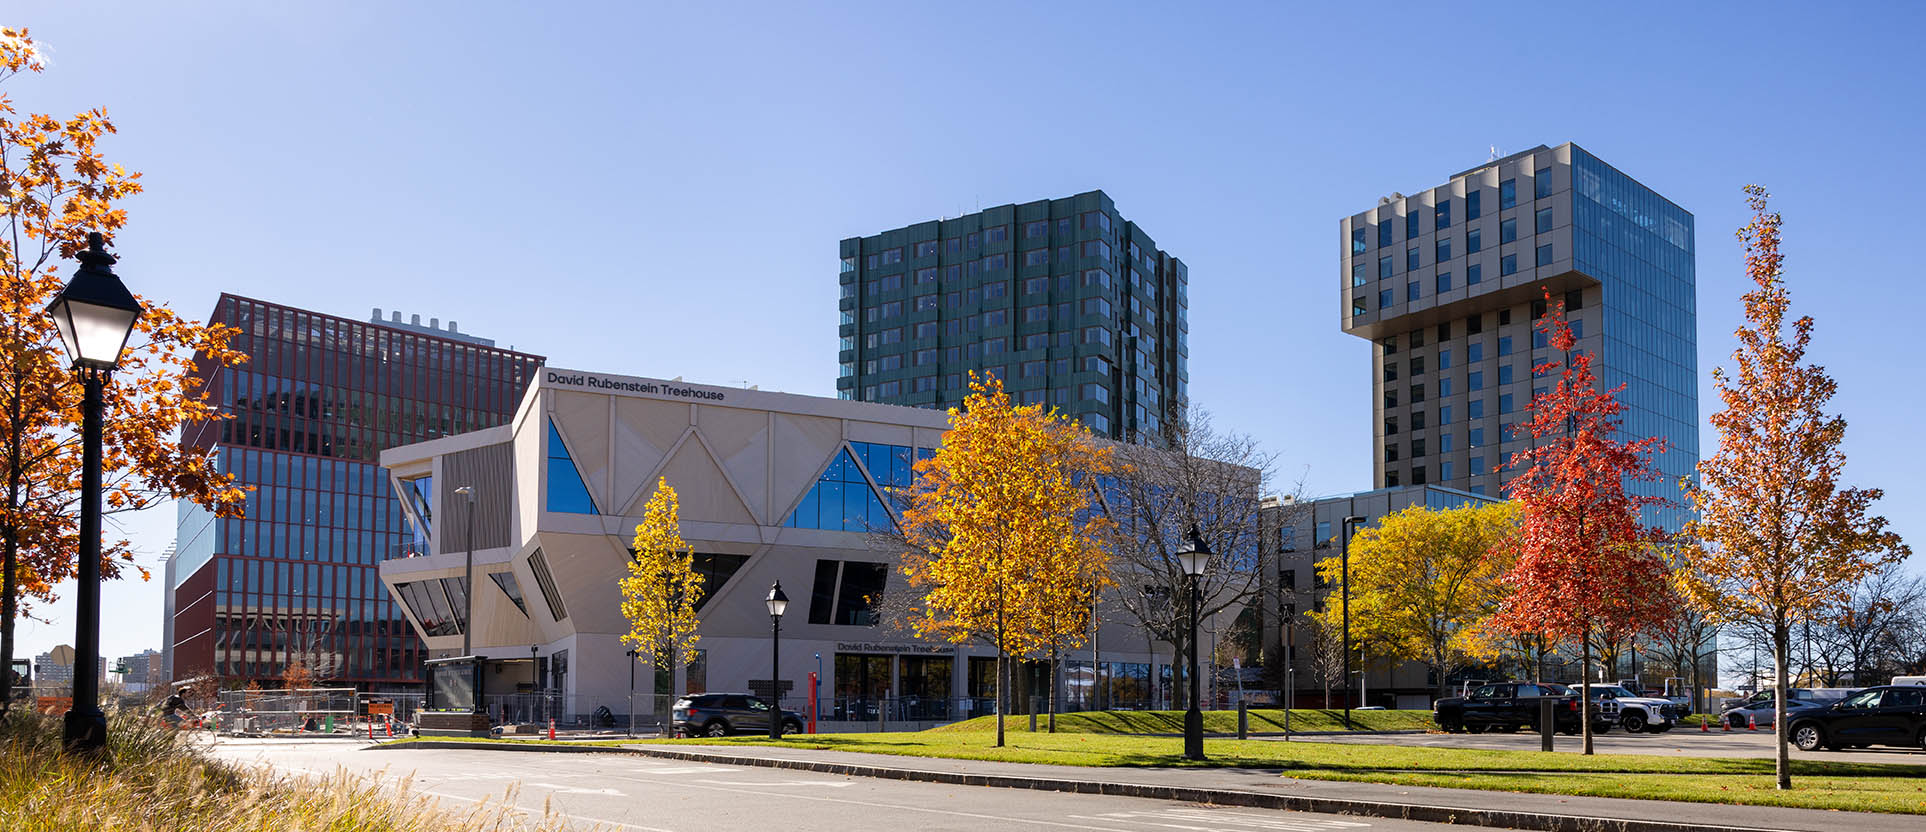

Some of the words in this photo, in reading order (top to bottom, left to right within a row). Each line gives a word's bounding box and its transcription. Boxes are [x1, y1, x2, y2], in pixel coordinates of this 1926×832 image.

[548, 372, 584, 386] David
[588, 376, 658, 394] Rubenstein
[661, 384, 725, 401] Treehouse
[838, 643, 862, 651] David
[864, 643, 910, 653] Rubenstein
